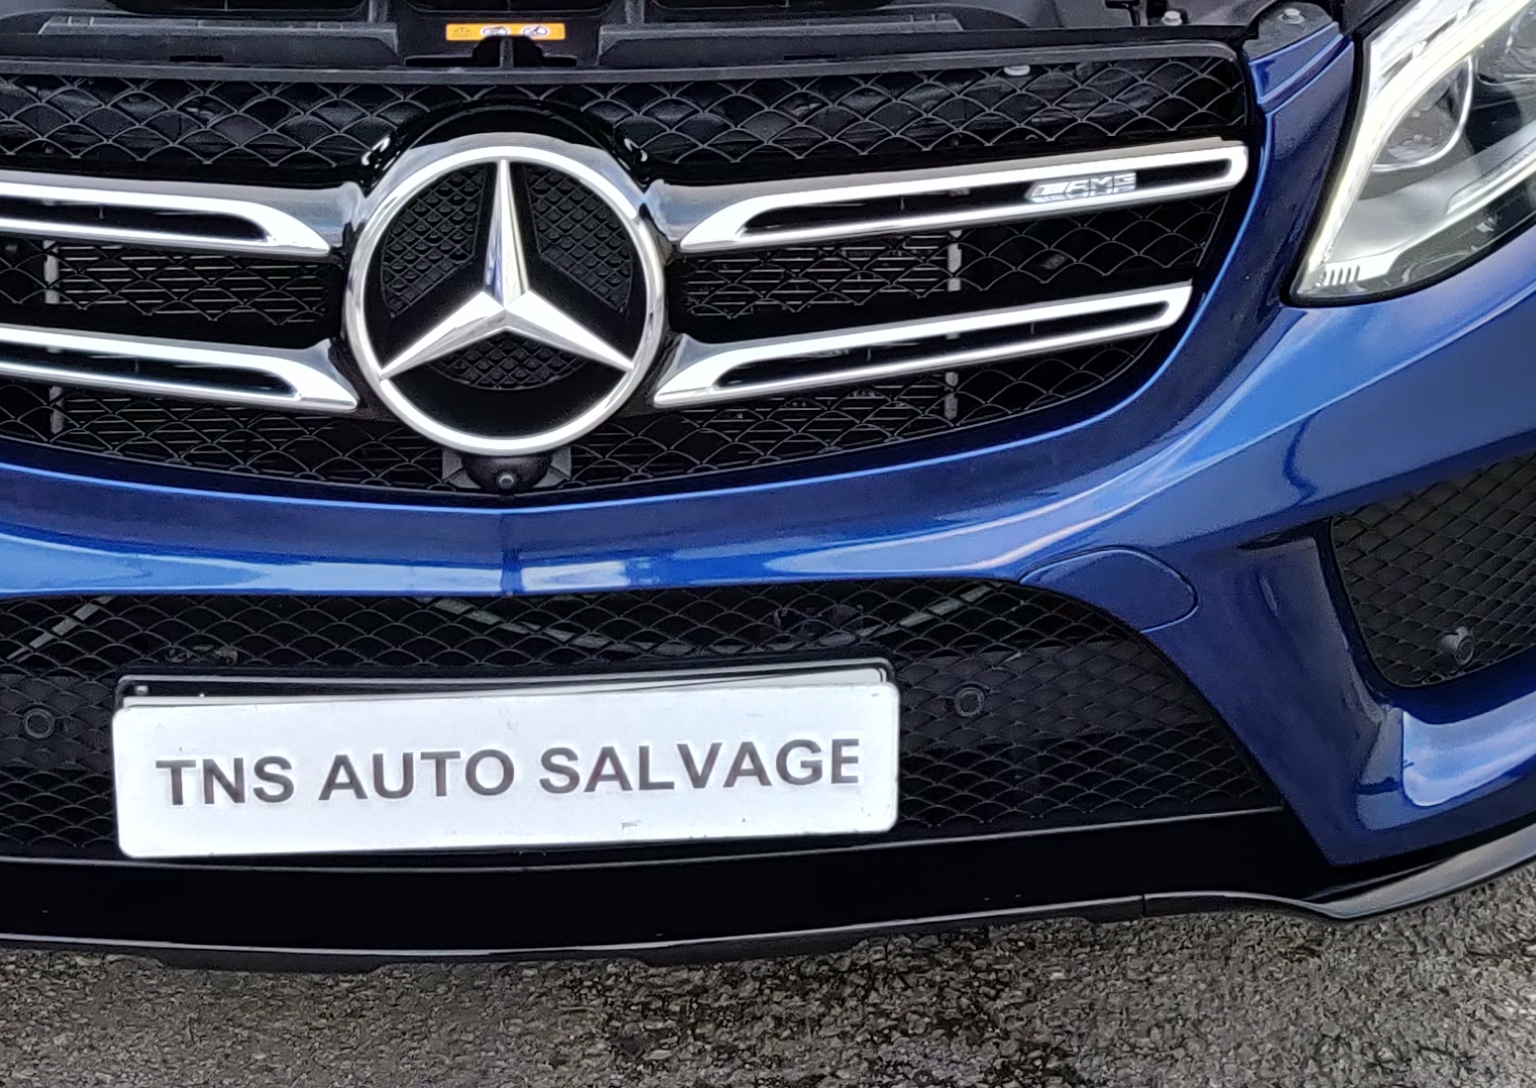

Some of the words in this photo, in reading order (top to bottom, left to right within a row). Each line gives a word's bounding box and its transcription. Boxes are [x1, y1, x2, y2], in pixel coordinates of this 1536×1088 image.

[155, 755, 295, 806] TNS
[317, 749, 515, 801] AUTO
[539, 738, 860, 794] SALVAGE
